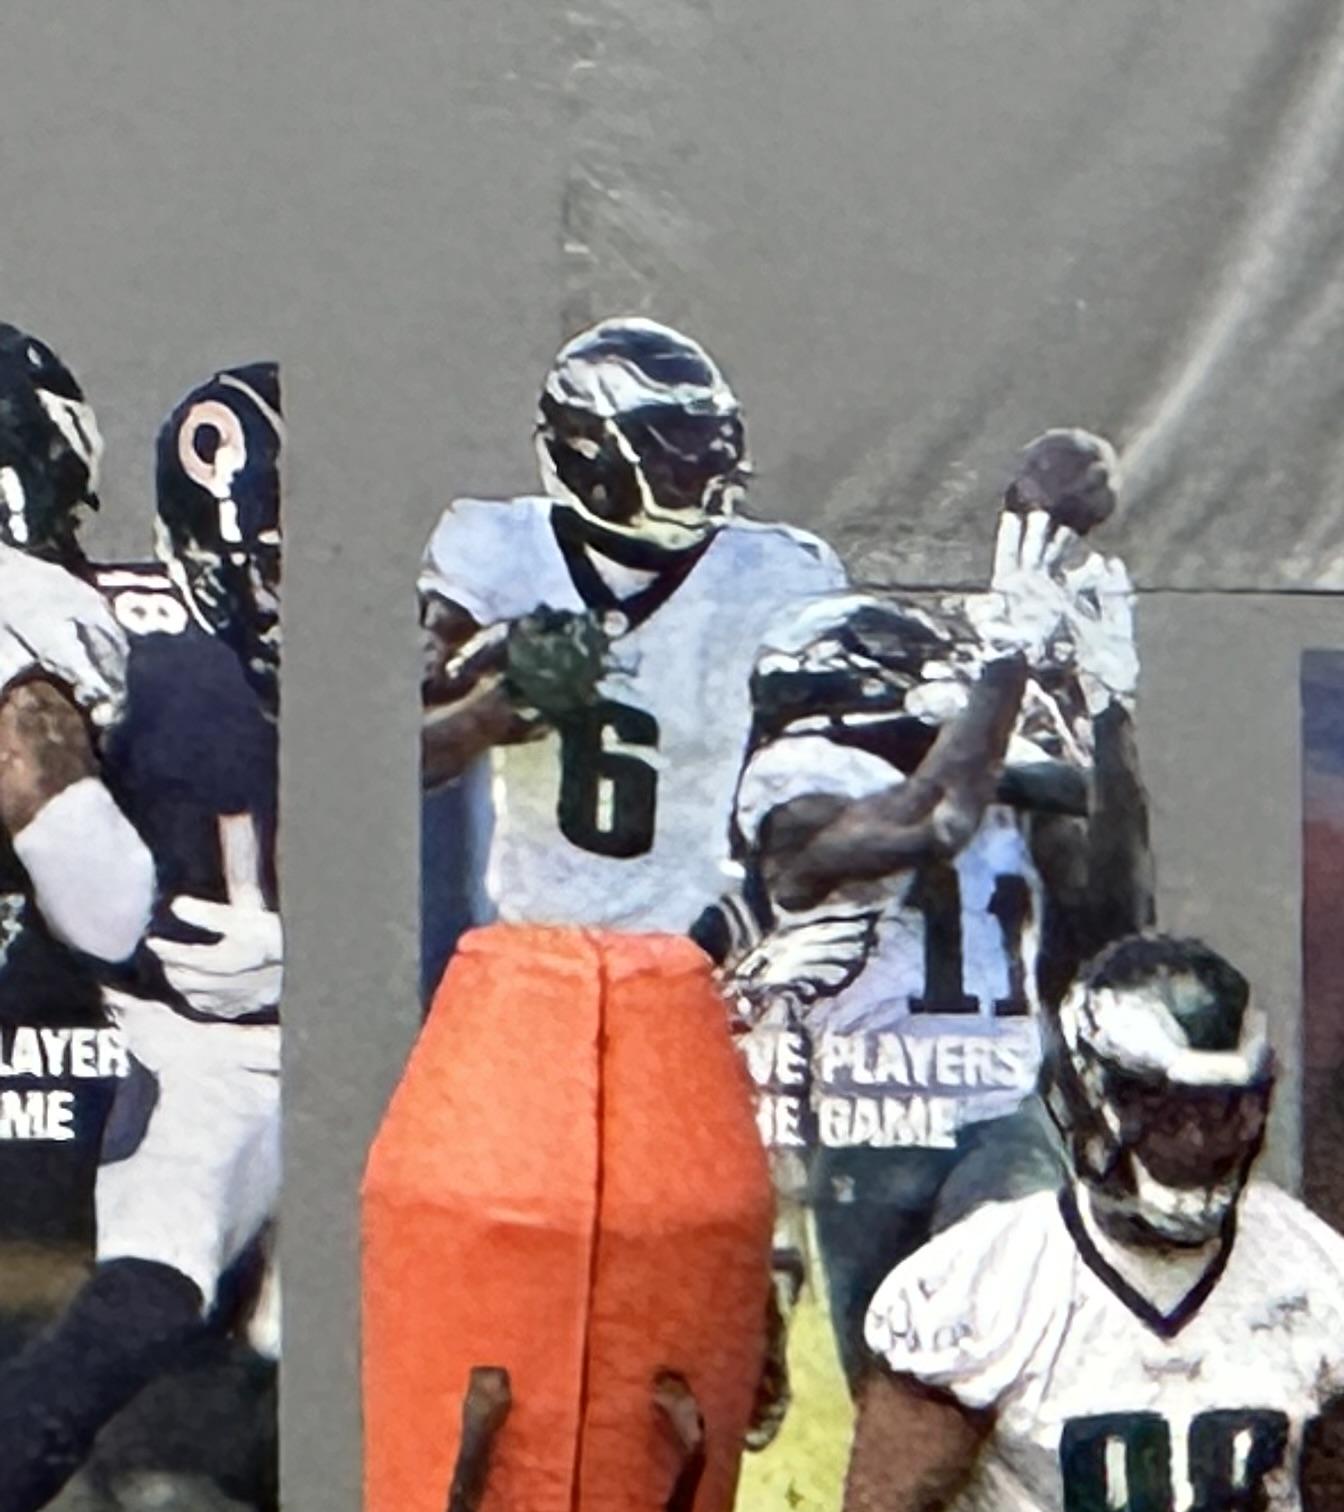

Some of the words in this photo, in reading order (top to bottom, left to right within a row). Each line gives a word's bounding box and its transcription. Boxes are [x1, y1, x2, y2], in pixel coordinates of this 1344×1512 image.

[743, 1032, 804, 1085] VE
[822, 1031, 1025, 1087] PLAYERS
[818, 1095, 956, 1149] GAME
